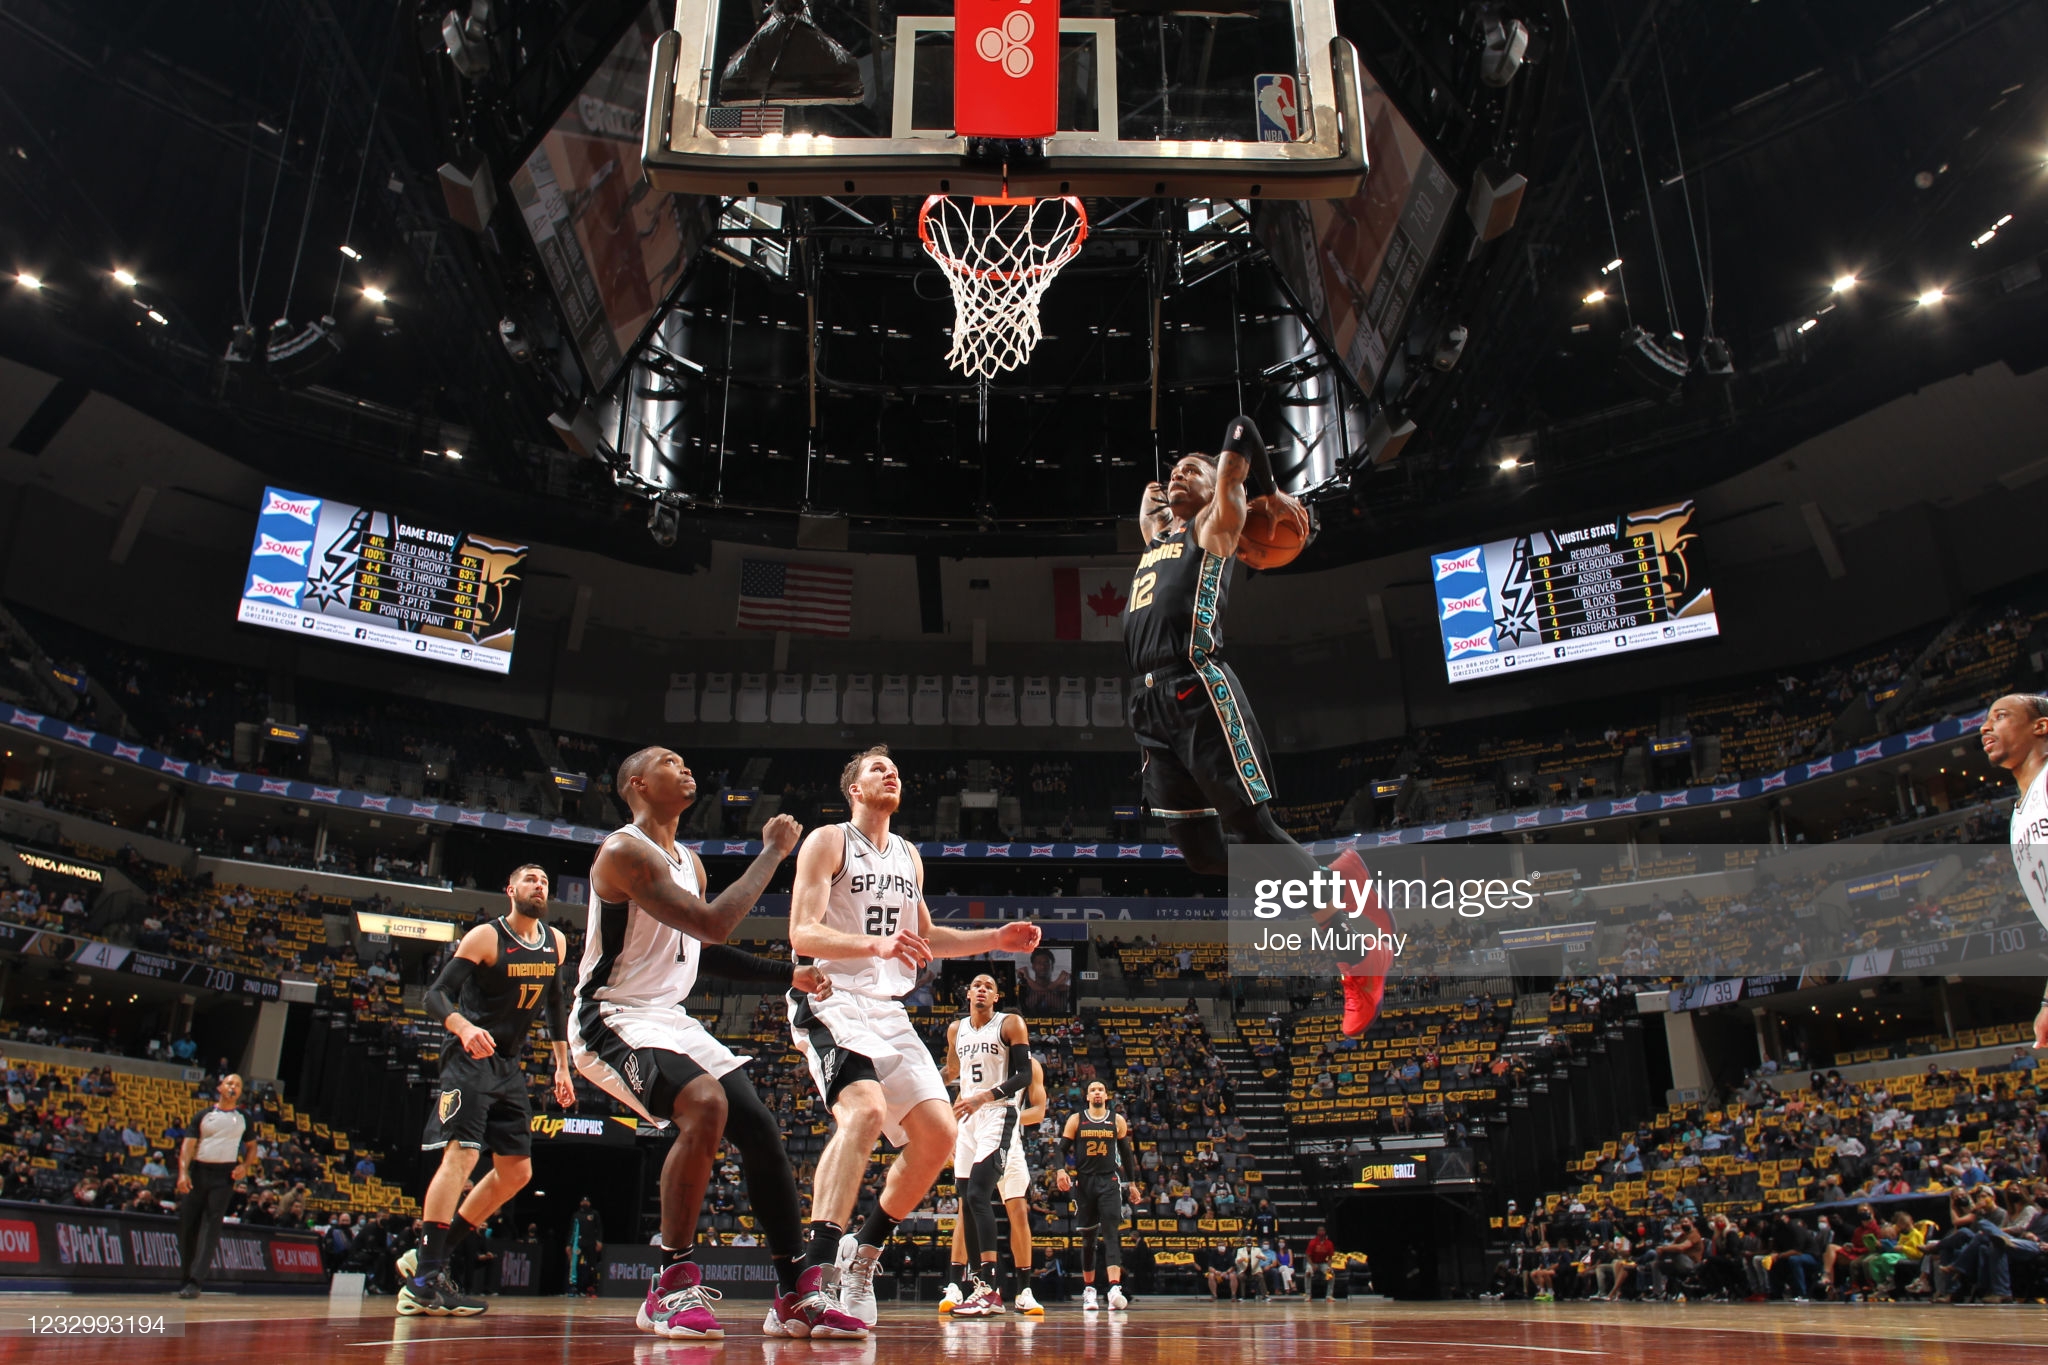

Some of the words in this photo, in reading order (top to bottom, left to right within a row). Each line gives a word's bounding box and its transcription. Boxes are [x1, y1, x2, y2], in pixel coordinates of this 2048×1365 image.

[1264, 130, 1284, 142] NBA
[272, 500, 311, 516] SONIC
[399, 524, 426, 540] GAME
[426, 531, 455, 547] STATS
[1559, 531, 1590, 545] HUSTLE
[1590, 523, 1616, 538] STATS
[263, 541, 303, 557] SONIC
[370, 536, 385, 548] 41%
[395, 541, 417, 555] FIELD
[418, 547, 445, 562] GOALS
[445, 553, 453, 563] %
[461, 557, 477, 568] 47%
[1539, 556, 1550, 567] 20
[1570, 543, 1610, 560] REBOUNDS
[1633, 536, 1645, 548] 22
[364, 548, 386, 561] 100%
[391, 554, 413, 567] FREE
[413, 559, 444, 574] THROW
[444, 566, 451, 576] %
[459, 569, 476, 581] 63%
[1441, 557, 1475, 573] SONIC
[1543, 569, 1549, 578] 6
[1561, 562, 1577, 575] OFF
[1578, 553, 1624, 571] REBOUNDS
[1638, 549, 1645, 559] 5
[366, 562, 380, 573] 4-4
[390, 567, 410, 580] FREE
[413, 571, 448, 588] THROWS
[458, 582, 473, 593] 5-8
[1545, 581, 1552, 591] 9
[1578, 569, 1612, 584] ASSISTS
[1639, 562, 1648, 572] 10
[255, 582, 295, 598] SONIC
[361, 574, 379, 586] 30%
[396, 582, 417, 596] 3-PT
[417, 586, 428, 598] FG
[454, 594, 471, 606] 40%
[1130, 571, 1157, 612] 12
[1547, 594, 1554, 603] 2
[1572, 580, 1622, 599] TURNOVERS
[1643, 574, 1649, 584] 4
[360, 587, 379, 599] 3-10
[398, 595, 418, 608] 3-PT
[419, 599, 430, 610] FG
[454, 607, 471, 619] 4-10
[1447, 597, 1481, 612] SONIC
[1550, 606, 1556, 615] 3
[1582, 594, 1616, 610] BLOCKS
[1645, 587, 1651, 597] 3
[359, 600, 371, 612] 20
[379, 604, 410, 620] POINTS
[410, 611, 420, 622] IN
[421, 612, 445, 627] PAINT
[454, 621, 463, 631] 18
[1552, 618, 1558, 627] 4
[1586, 606, 1617, 621] STEALS
[1647, 600, 1654, 610] 2
[1553, 630, 1560, 640] 2
[1571, 619, 1619, 637] FASTBREAK
[1620, 615, 1637, 628] PTS
[1649, 612, 1655, 622] 7
[1453, 636, 1487, 651] SONIC
[1453, 664, 1500, 678] GRIZZLIES.COM
[1908, 732, 1931, 745] SONIC
[1857, 748, 1878, 760] SONIC
[1763, 776, 1784, 787] SONIC
[1715, 788, 1737, 798] SONIC
[365, 798, 386, 808] SONIC
[414, 806, 435, 816] SONIC
[1614, 802, 1635, 812] SONIC
[461, 813, 482, 823] SONIC
[1517, 815, 1537, 824] SONIC
[1564, 808, 1585, 818] SONIC
[507, 820, 528, 830] SONIC
[551, 827, 572, 836] SONIC
[1425, 829, 1444, 837] SONIC
[1470, 822, 1490, 831] SONIC
[1380, 835, 1399, 844] SONIC
[685, 844, 702, 852] ONIC
[1077, 847, 1096, 855] SONIC
[1120, 847, 1140, 855] SONIC
[58, 863, 102, 882] MINOLTA
[850, 874, 914, 900] SPURS
[866, 905, 900, 936] 25
[1157, 909, 1180, 917] IT'S
[1185, 909, 1215, 917] ONLY
[393, 924, 428, 935] LOTTERY
[1984, 928, 2027, 955] 7:00
[95, 946, 112, 968] 41
[1901, 944, 1940, 959] TIMEOUTS:
[507, 963, 556, 979] memphis
[1864, 956, 1878, 975] 41
[1903, 957, 1927, 969] FOULS:
[205, 967, 235, 992] 7:00
[243, 980, 260, 993] 2ND
[261, 984, 279, 997] QTR
[1714, 982, 1733, 1002] 39
[516, 984, 544, 1010] 17
[958, 1043, 999, 1059] SPURS
[971, 1064, 982, 1083] 5
[542, 1117, 565, 1138] UP
[563, 1118, 604, 1135] MEMPHIS
[1080, 1129, 1114, 1139] memphis
[1086, 1141, 1108, 1157] 24
[1362, 1163, 1416, 1182] @MEMGRIZZ
[69, 1223, 124, 1266] Pick'Em
[130, 1230, 182, 1267] PLAYOFFS
[220, 1238, 266, 1271] CHALLENGE
[276, 1249, 298, 1267] PLAY
[299, 1250, 319, 1268] NOW
[617, 1262, 655, 1280] Pick'Em
[705, 1264, 743, 1281] BRACKET
[743, 1264, 779, 1281] CHALLEN
